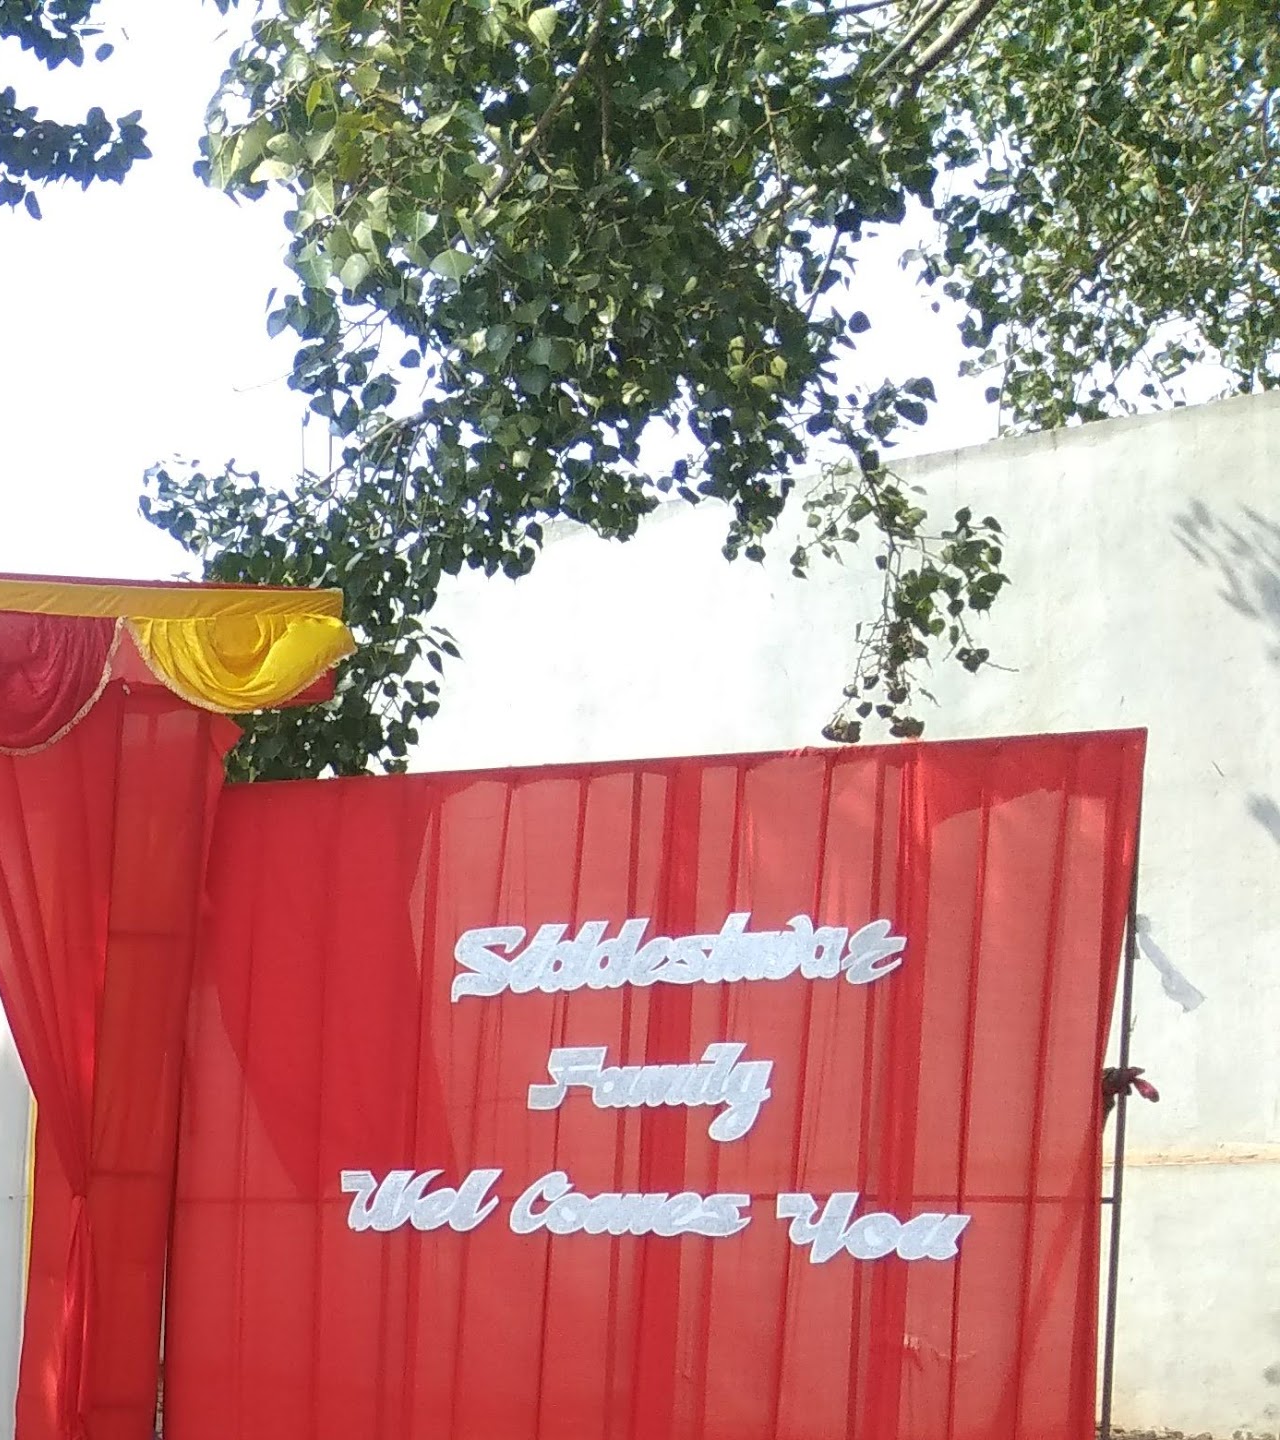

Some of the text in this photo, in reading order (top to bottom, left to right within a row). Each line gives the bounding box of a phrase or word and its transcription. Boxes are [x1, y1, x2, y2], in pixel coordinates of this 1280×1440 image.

[450, 912, 907, 1003] Siddeshwar
[528, 1043, 773, 1142] Family
[340, 1169, 971, 1264] Wel Comes You
